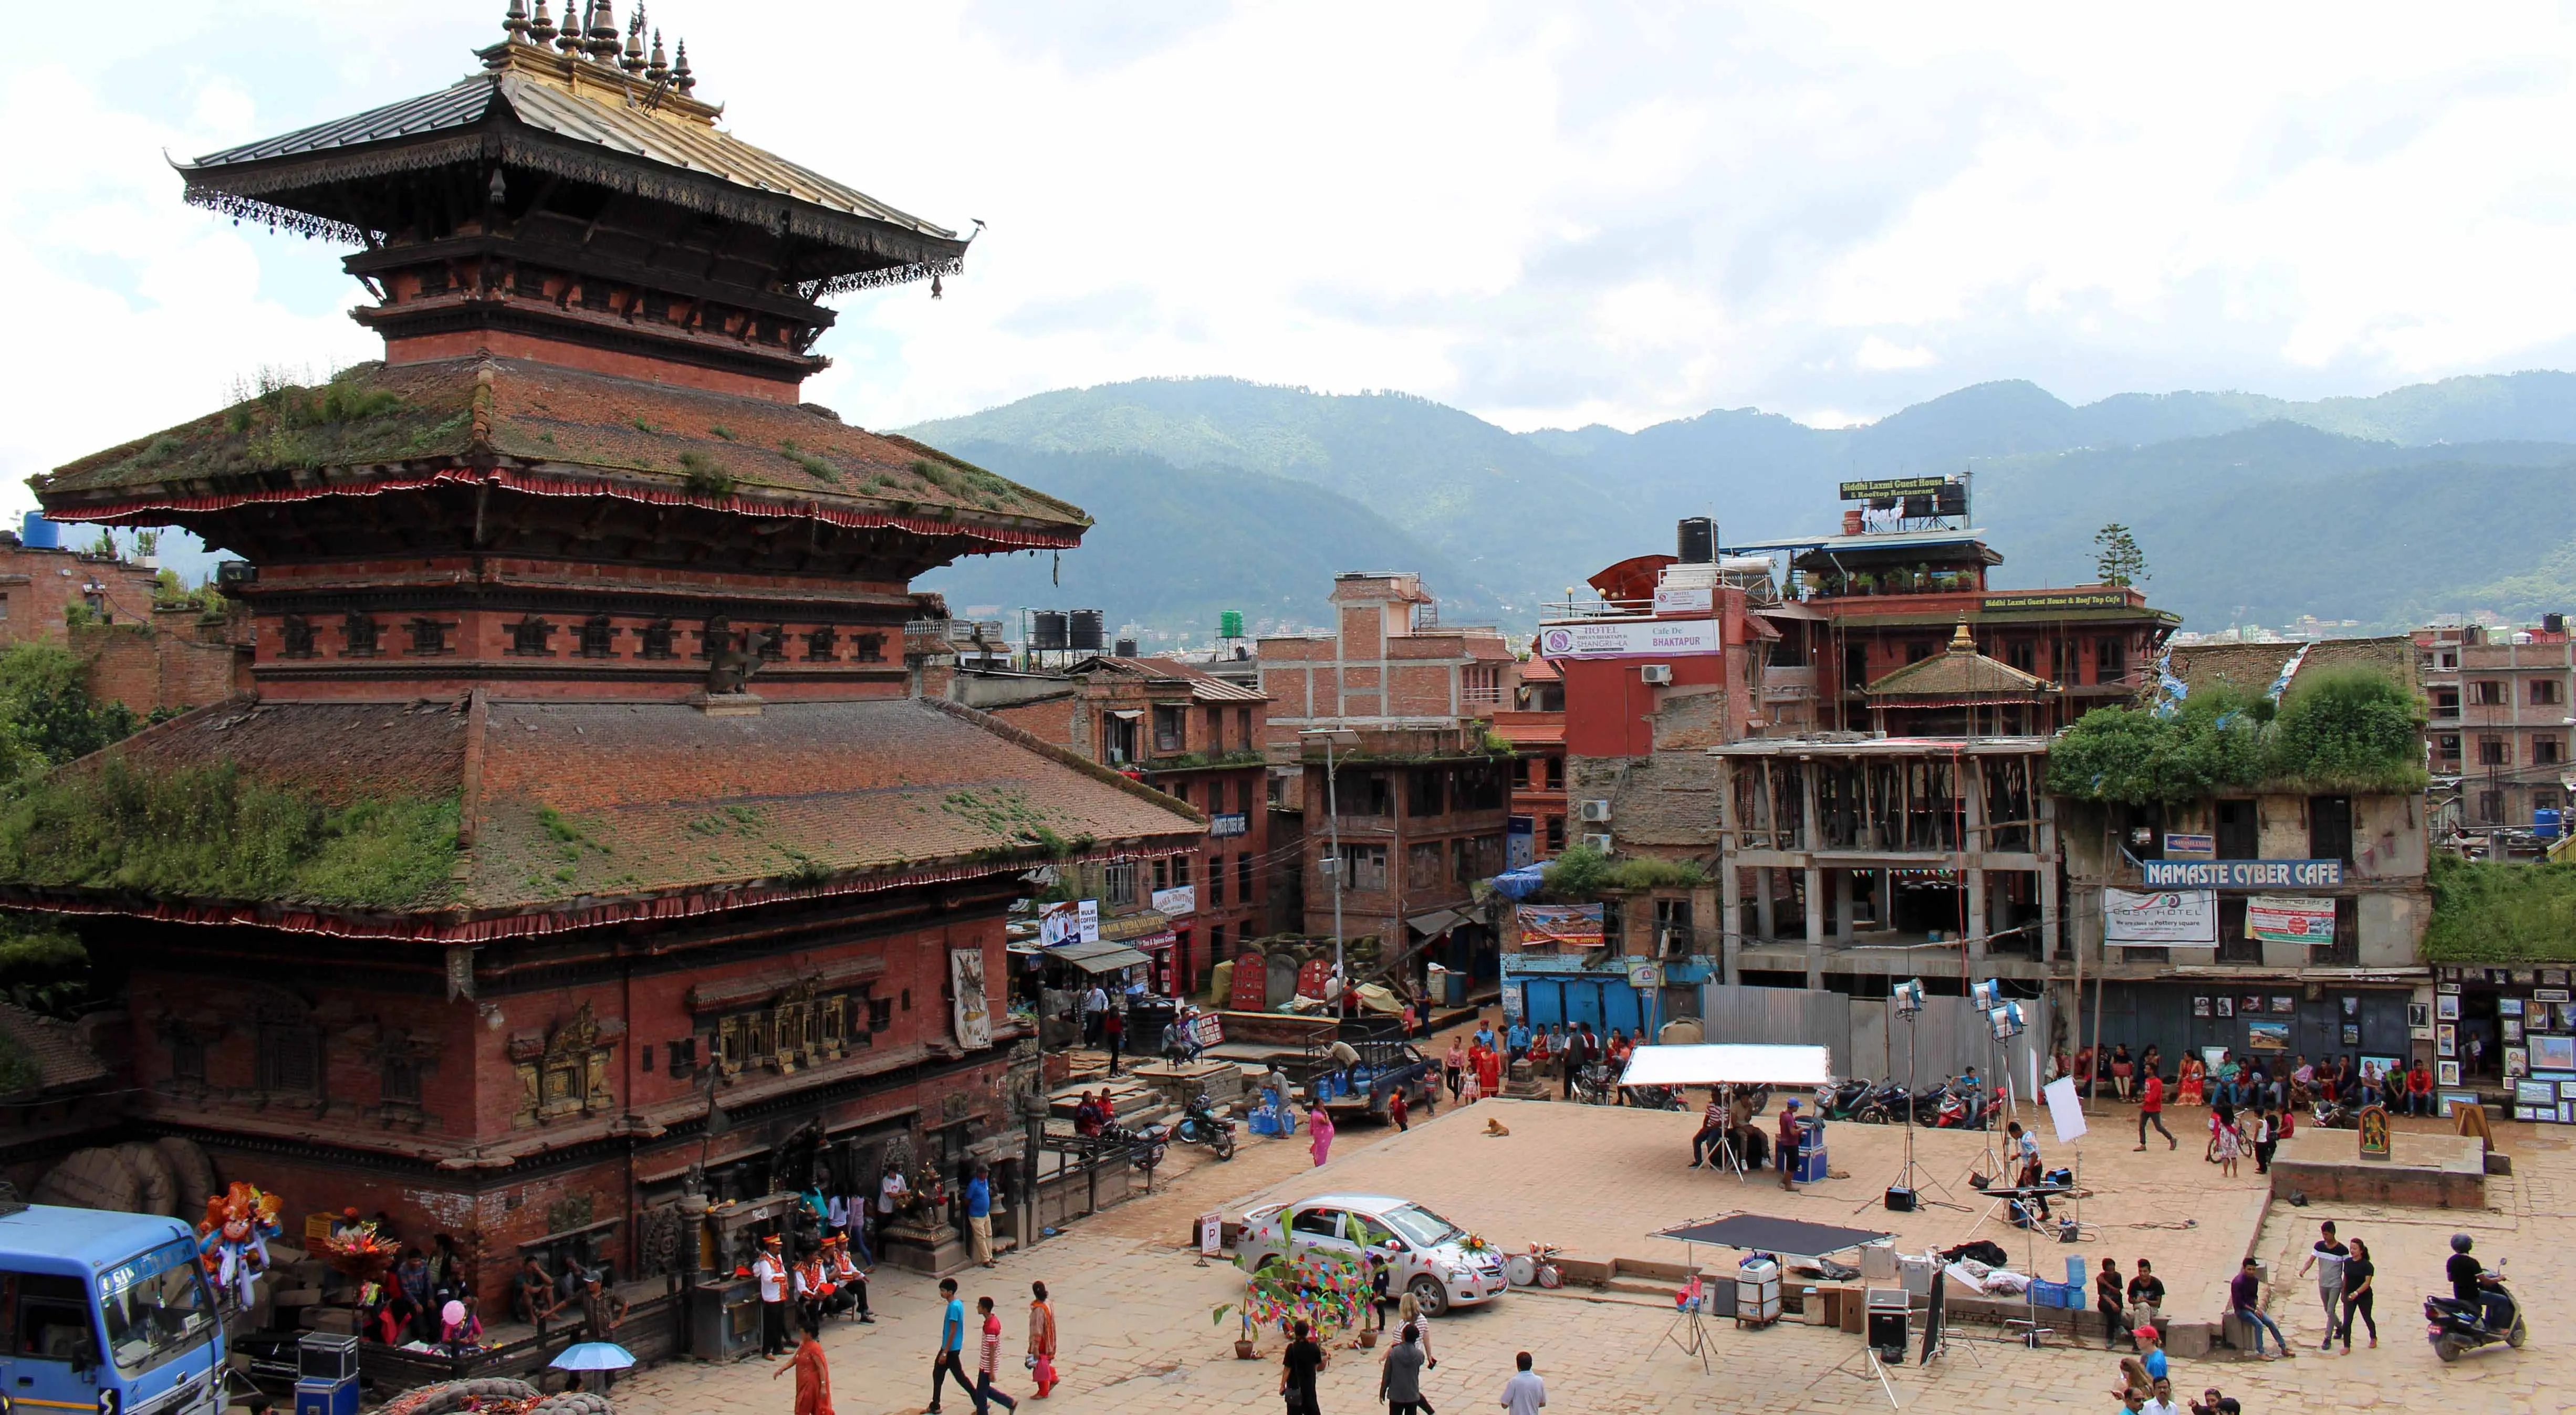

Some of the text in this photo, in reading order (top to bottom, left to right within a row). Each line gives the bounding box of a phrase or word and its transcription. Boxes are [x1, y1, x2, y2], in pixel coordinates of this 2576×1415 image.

[1842, 478, 1943, 491] Siddhi Laxmi Guest House
[1584, 626, 1619, 634] HOTEL
[1653, 637, 1700, 646] BHAKTAPUR
[2149, 864, 2339, 886] NAMASTE CYBER CAFE
